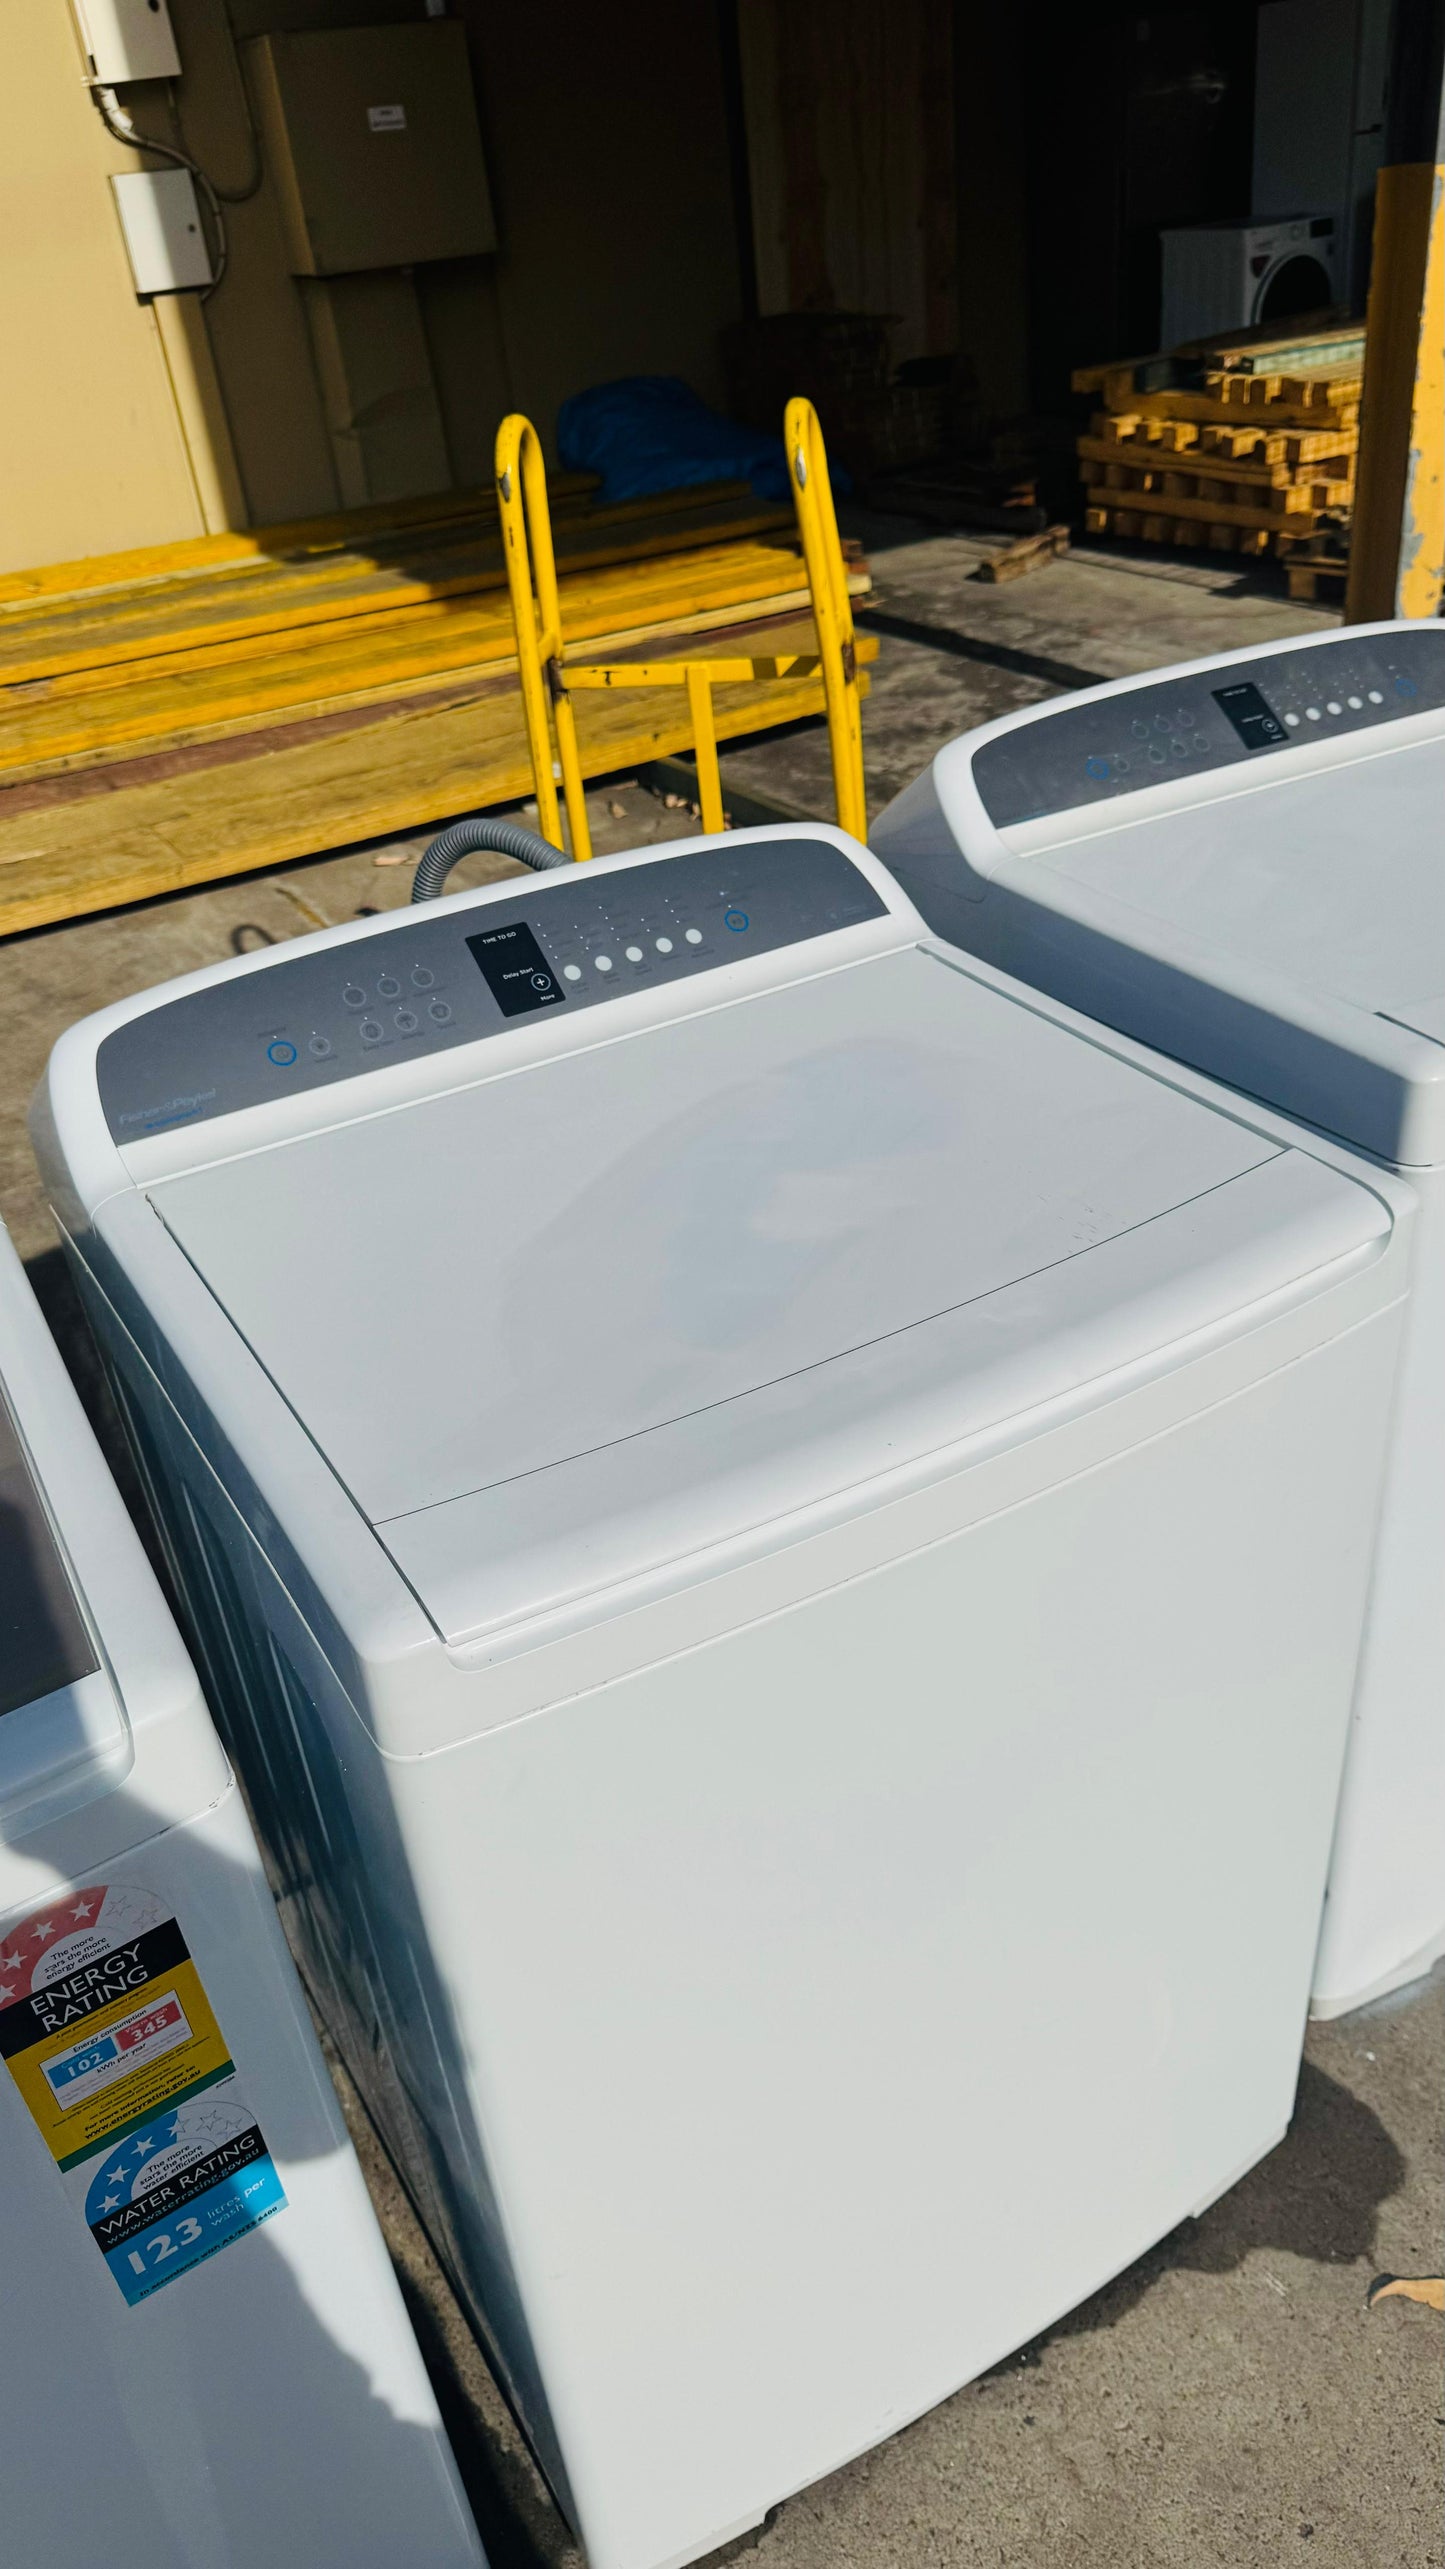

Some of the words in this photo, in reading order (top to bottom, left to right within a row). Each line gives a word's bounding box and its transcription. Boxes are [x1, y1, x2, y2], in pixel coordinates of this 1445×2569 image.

[482, 937, 497, 945] TIME
[502, 972, 519, 980] Delay
[519, 967, 534, 975] Start
[46, 1962, 76, 1980] energy
[77, 1942, 112, 1964] efficient
[51, 1949, 70, 1961] The
[70, 1936, 95, 1952] more
[67, 1950, 83, 1962] the
[83, 1936, 108, 1953] more
[30, 1943, 141, 2016] ENERGY
[41, 1965, 149, 2033] RATING
[72, 2035, 99, 2053] Energy
[100, 2009, 148, 2038] consumption
[131, 2015, 168, 2042] 345
[67, 2052, 104, 2077] 102
[96, 2060, 116, 2074] kWh
[116, 2053, 130, 2063] per
[130, 2043, 147, 2056] year
[139, 2171, 162, 2186] stars
[162, 2160, 178, 2174] the
[179, 2145, 203, 2163] more
[143, 2175, 169, 2190] water
[170, 2151, 205, 2176] efficient
[146, 2159, 166, 2173] The
[167, 2145, 190, 2162] more
[99, 2186, 175, 2234] WATER
[178, 2134, 256, 2190] RATING
[207, 2194, 240, 2219] litres
[243, 2178, 266, 2199] per
[211, 2203, 244, 2227] wash
[127, 2217, 203, 2275] 123
